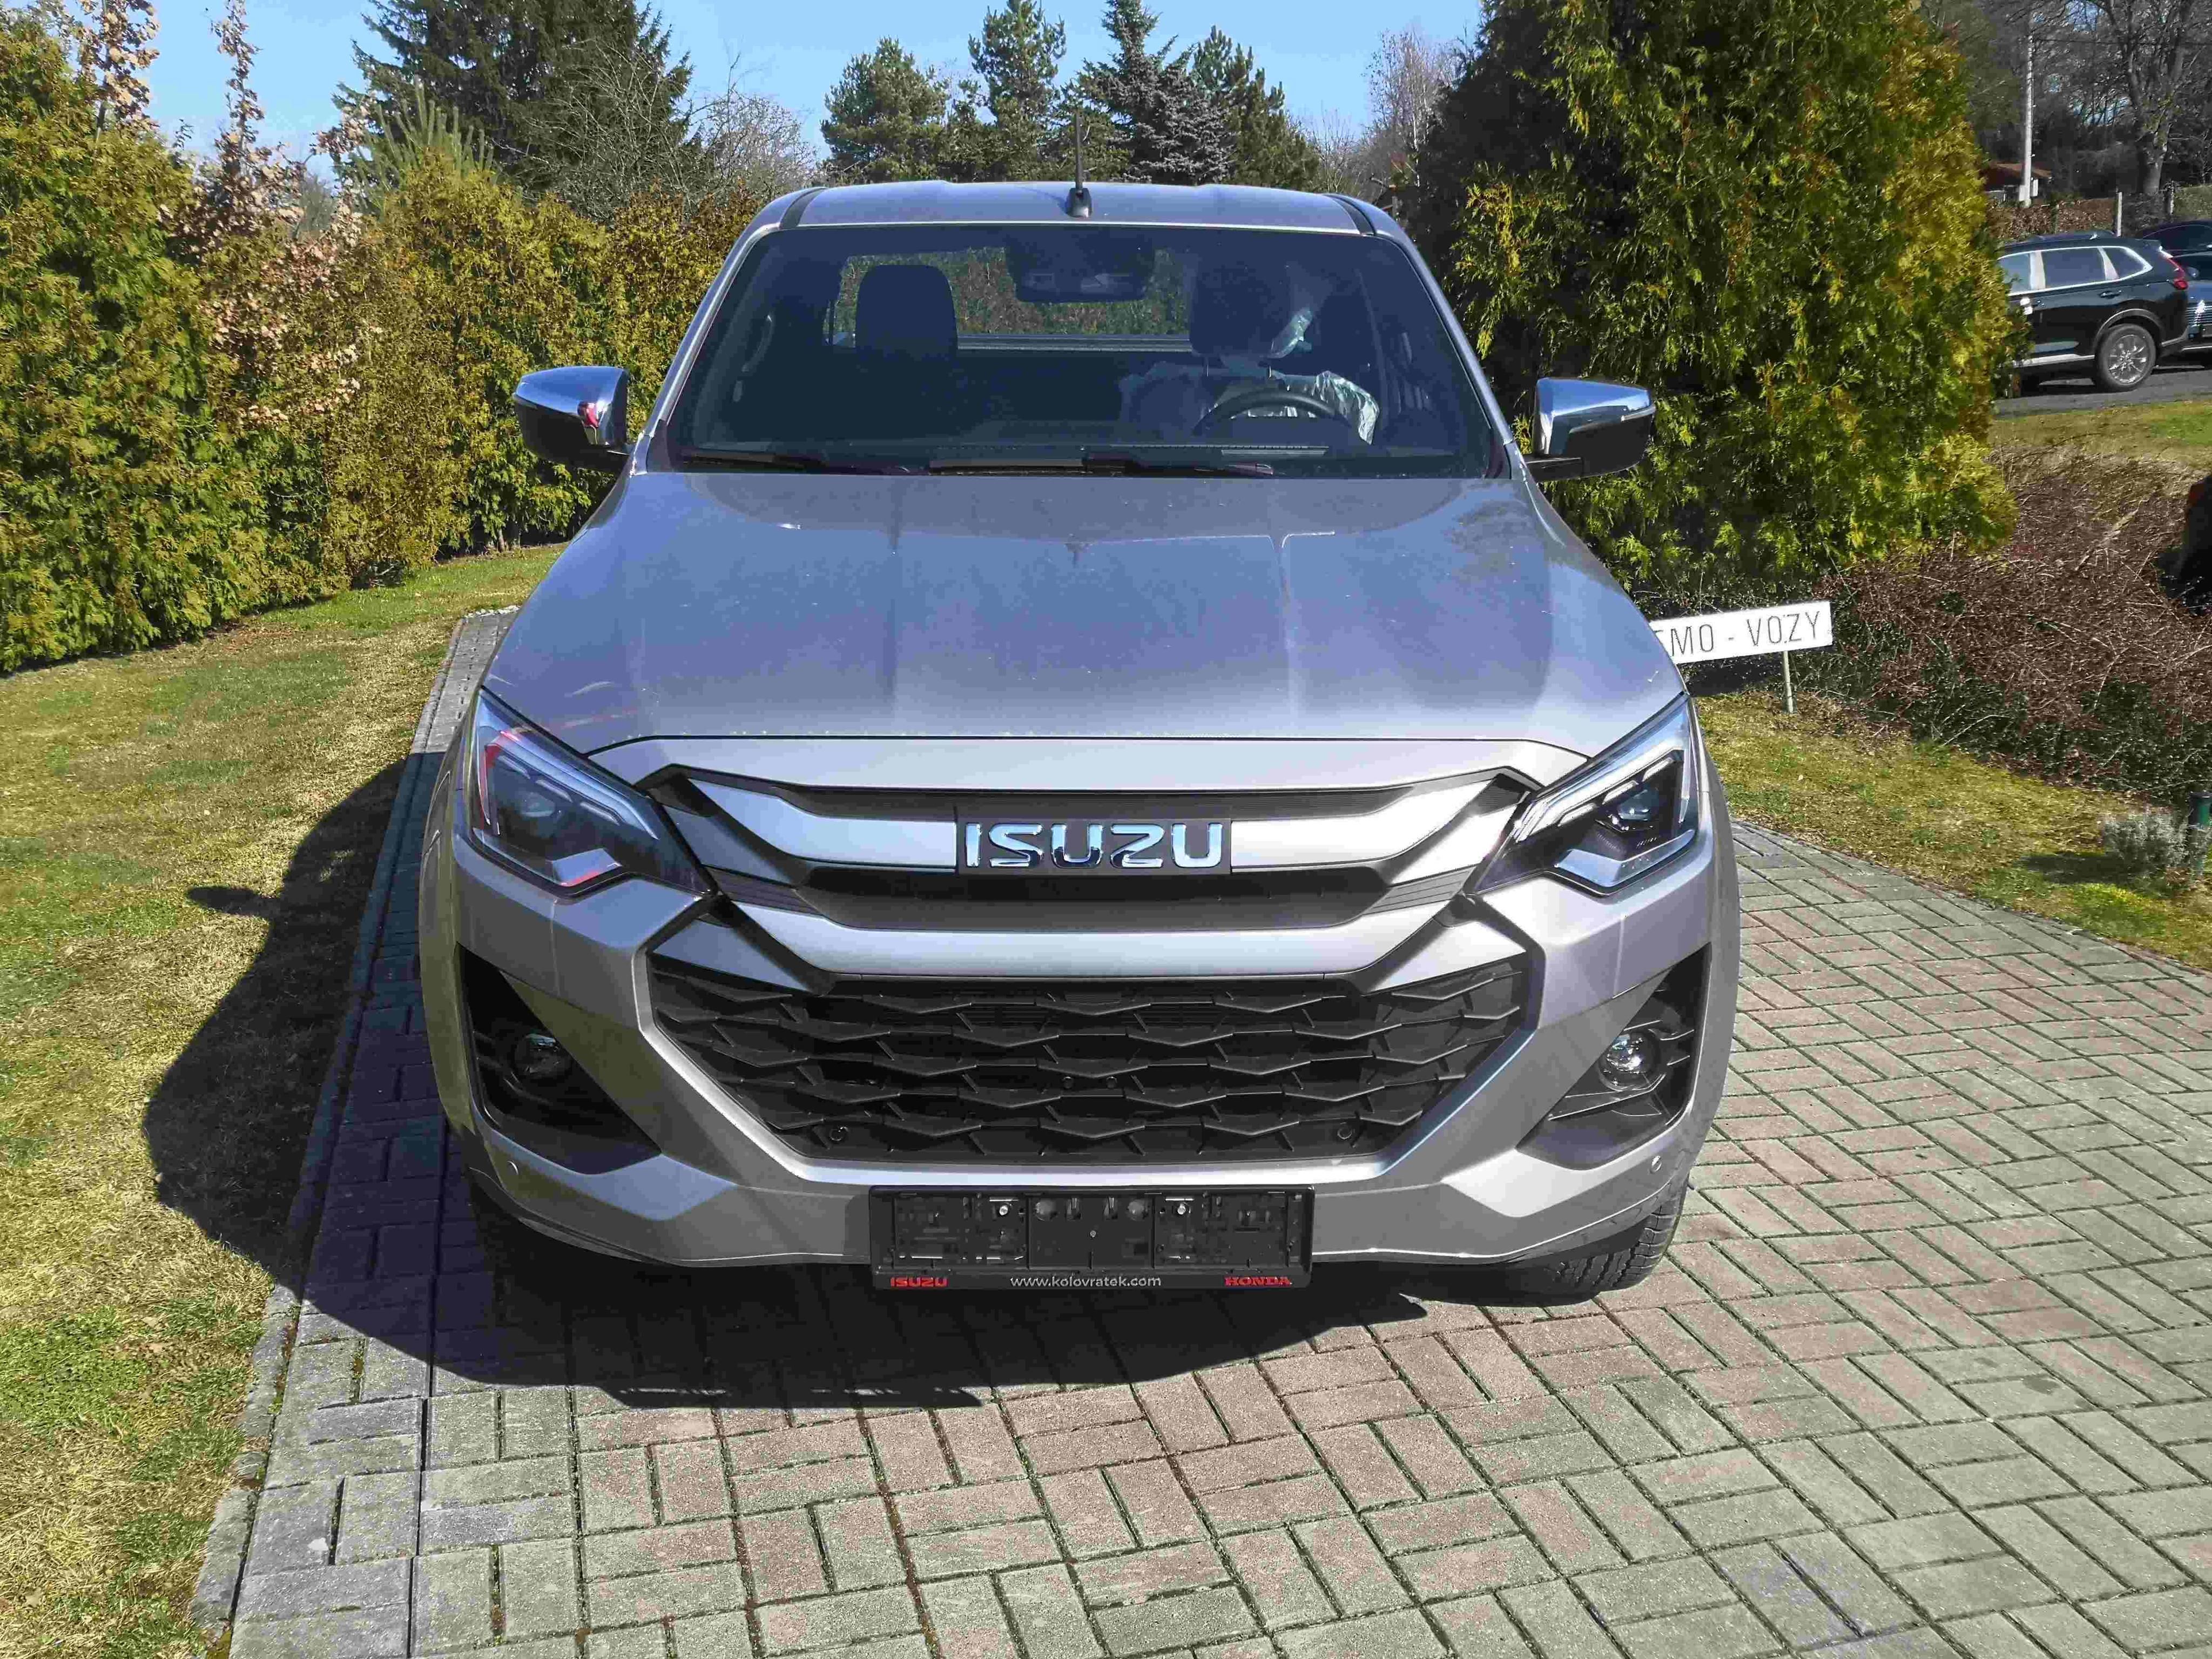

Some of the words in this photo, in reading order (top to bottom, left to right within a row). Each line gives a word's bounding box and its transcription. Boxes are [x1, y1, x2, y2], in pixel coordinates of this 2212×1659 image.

[1654, 624, 1714, 656] MO
[1746, 611, 1820, 646] VOZY
[965, 822, 1224, 868] ISUZU
[890, 1277, 948, 1287] ISUZU
[1010, 1275, 1162, 1287] www.kolovratek.com
[1224, 1276, 1292, 1287] HONDA
